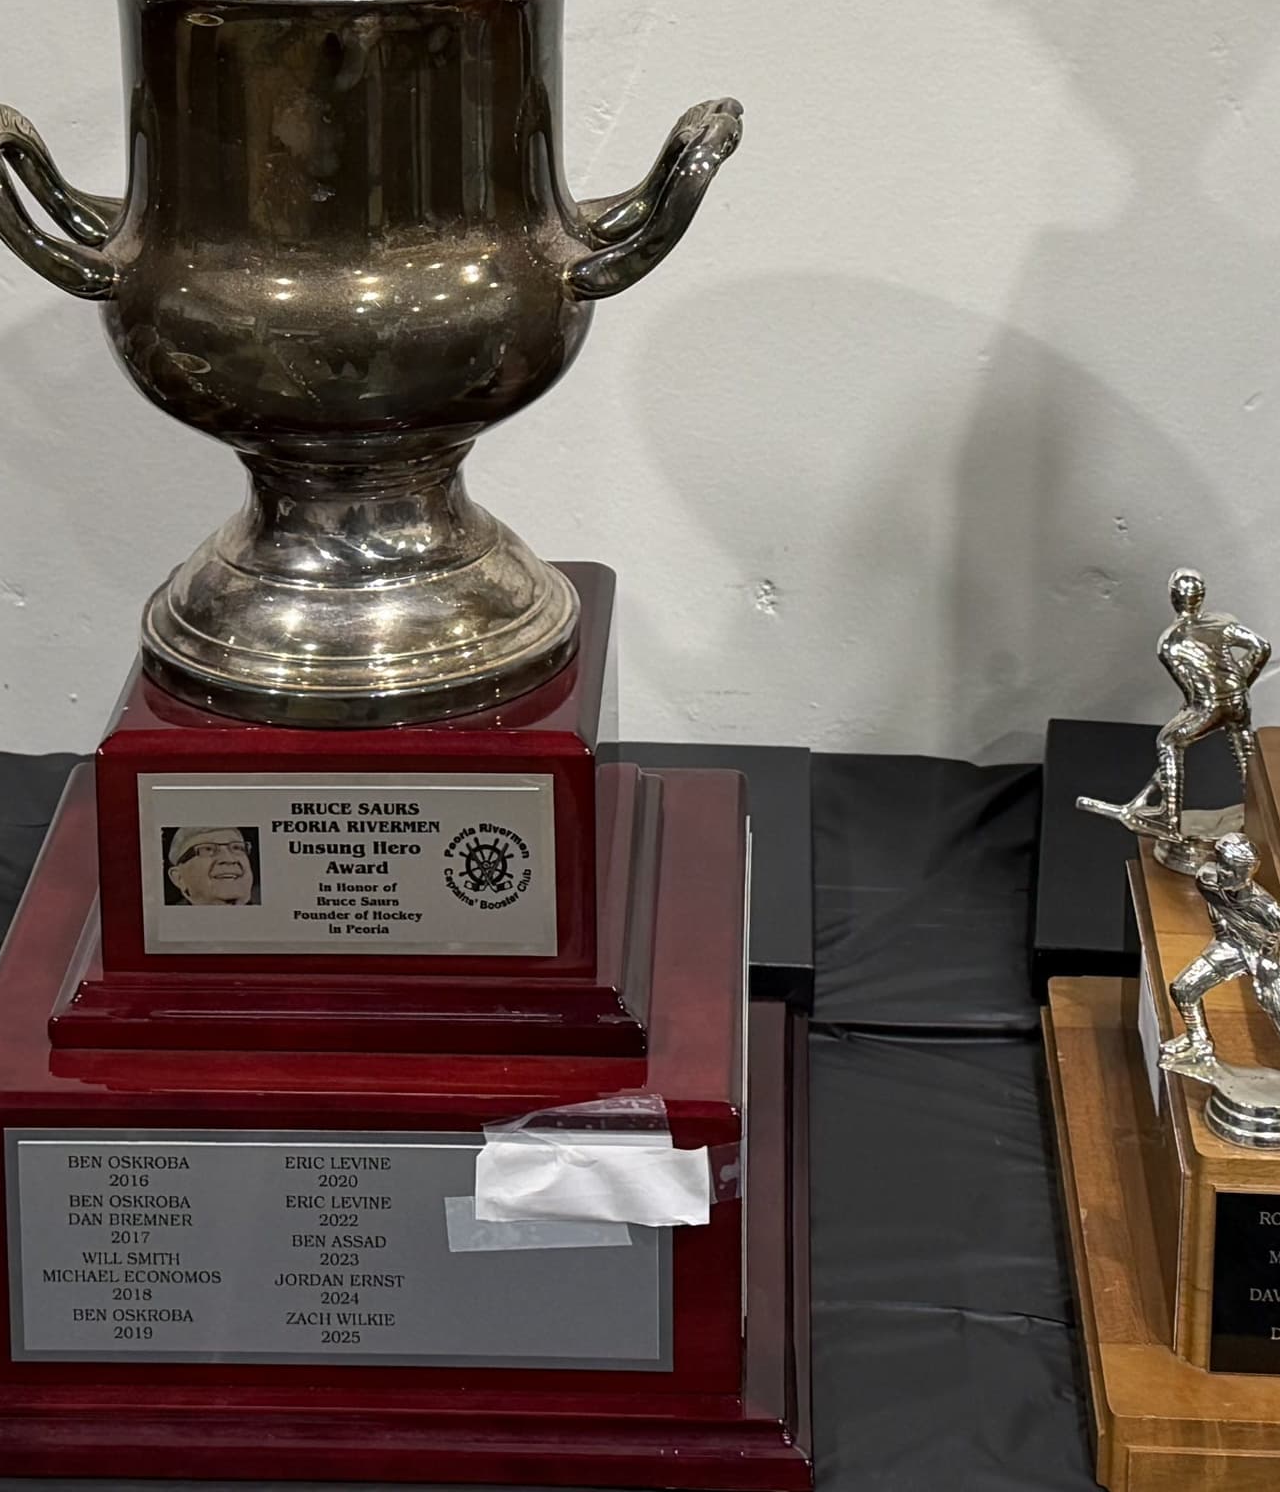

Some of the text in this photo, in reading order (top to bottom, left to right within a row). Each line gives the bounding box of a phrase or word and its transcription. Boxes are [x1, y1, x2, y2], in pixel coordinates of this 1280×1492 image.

[291, 803, 419, 815] BRUCE SAURS
[272, 820, 440, 833] PEORIA RIVERMEN
[288, 841, 420, 858] Unsung Hero
[326, 861, 388, 874] Award
[68, 1156, 190, 1169] BEN OSKROBA
[285, 1156, 391, 1171] ERIC LEVINE
[109, 1175, 149, 1187] 2016
[318, 1175, 358, 1188] 2020
[69, 1195, 191, 1209] BEN OSKROBA
[285, 1196, 391, 1210] ERIC LEVINE
[69, 1213, 192, 1226] DAN BREMNER
[319, 1214, 358, 1227] 2022
[111, 1232, 150, 1244] 2017
[292, 1235, 386, 1249] BEN ASSAD
[82, 1252, 180, 1265] WILL SMITH
[320, 1253, 359, 1266] 2023
[42, 1270, 222, 1284] MICHAEL ECONOMOS
[275, 1274, 405, 1288] JORDAN ERNST
[112, 1288, 152, 1301] 2018
[320, 1292, 359, 1305] 2024
[73, 1309, 194, 1322] BEN OSKROBA
[286, 1313, 395, 1326] ZACH WILKIE
[114, 1327, 153, 1340] 2019
[321, 1331, 360, 1344] 2025
